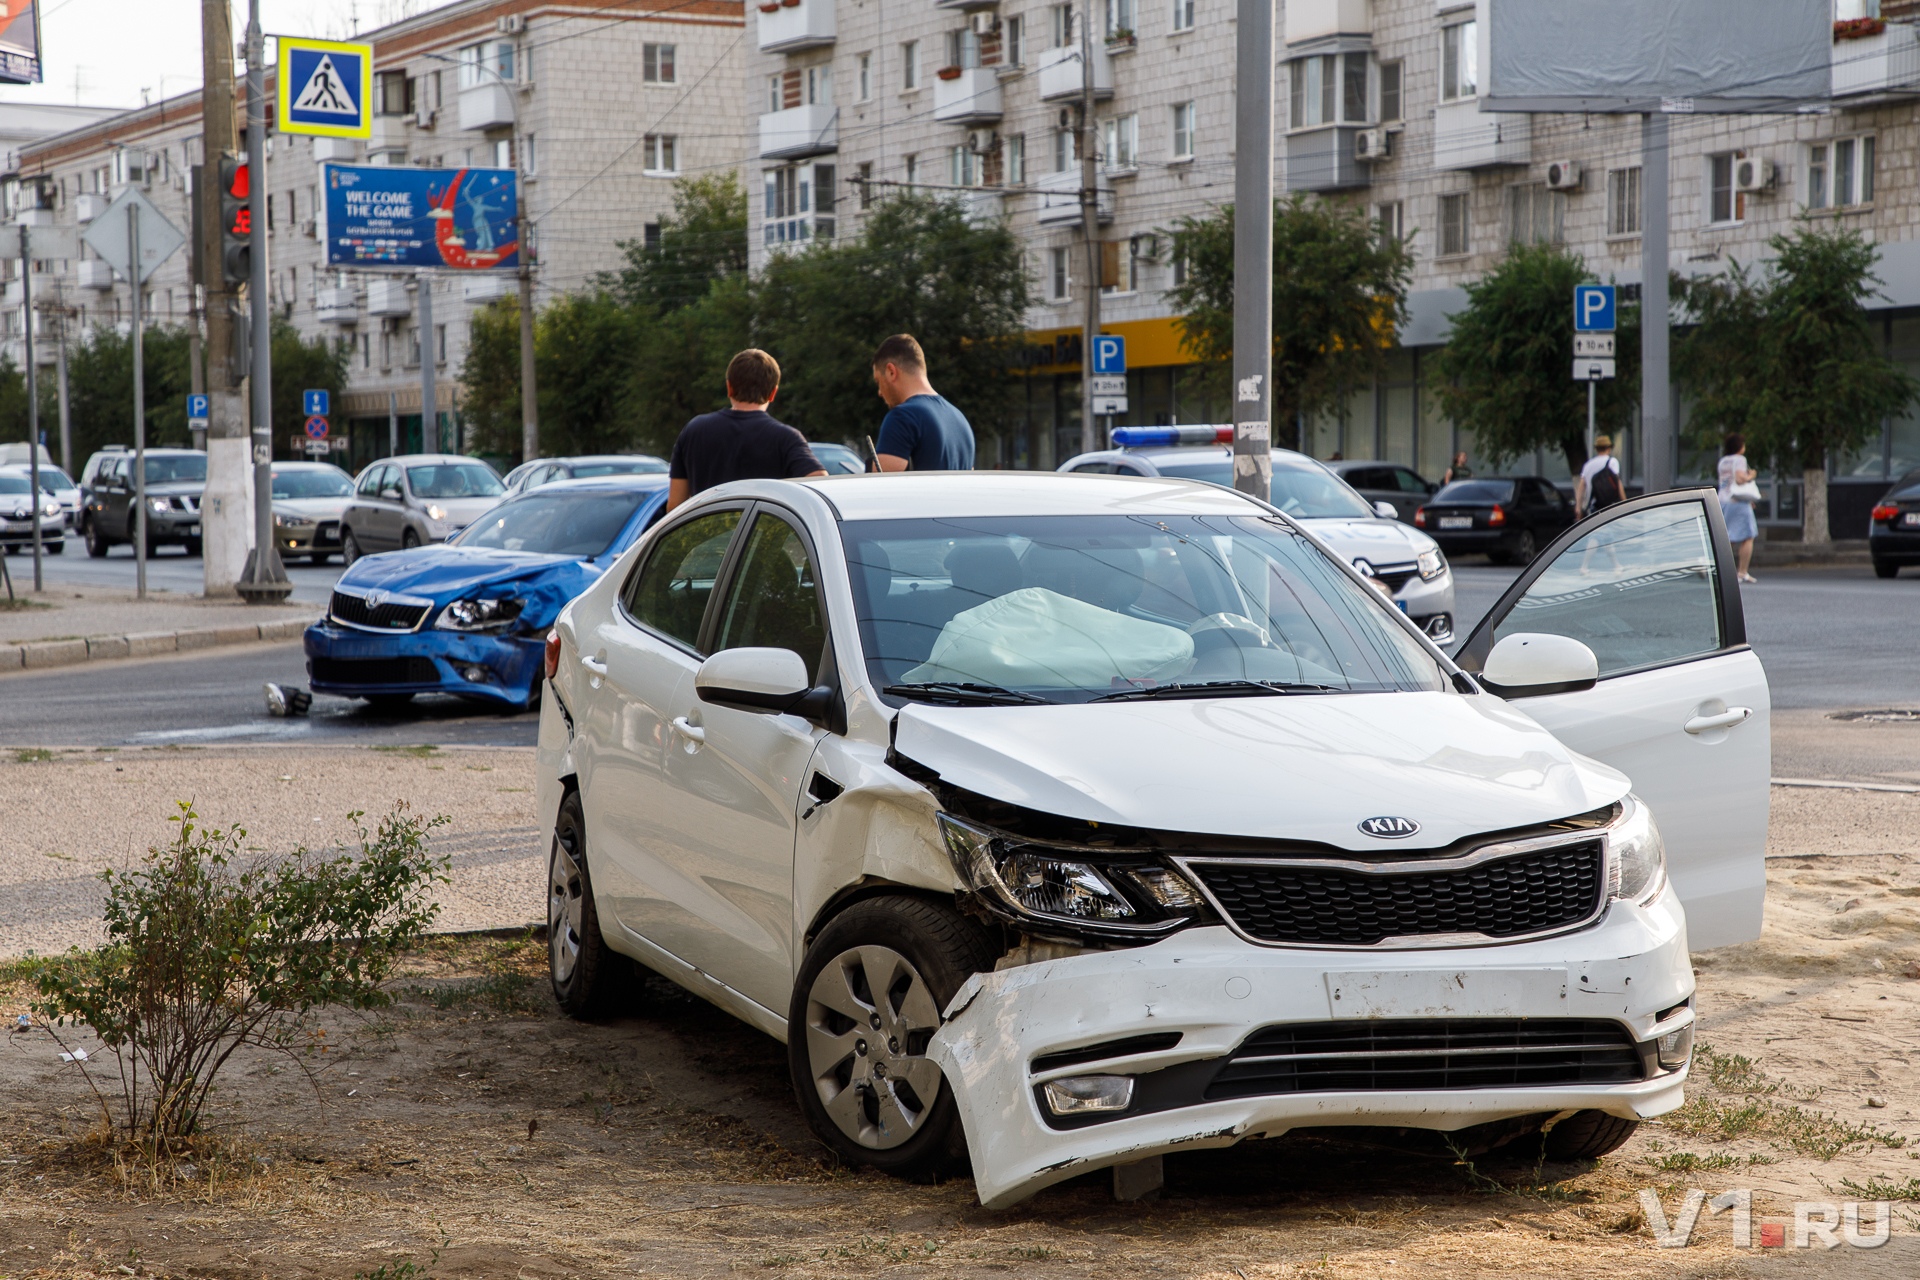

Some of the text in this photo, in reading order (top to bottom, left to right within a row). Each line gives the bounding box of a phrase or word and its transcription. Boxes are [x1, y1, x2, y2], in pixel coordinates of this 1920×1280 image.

[346, 190, 412, 205] WELCOME
[345, 204, 414, 219] THE GAME
[1584, 290, 1607, 327] P
[1100, 340, 1118, 370] P
[194, 396, 207, 416] P
[1366, 817, 1413, 833] KIA
